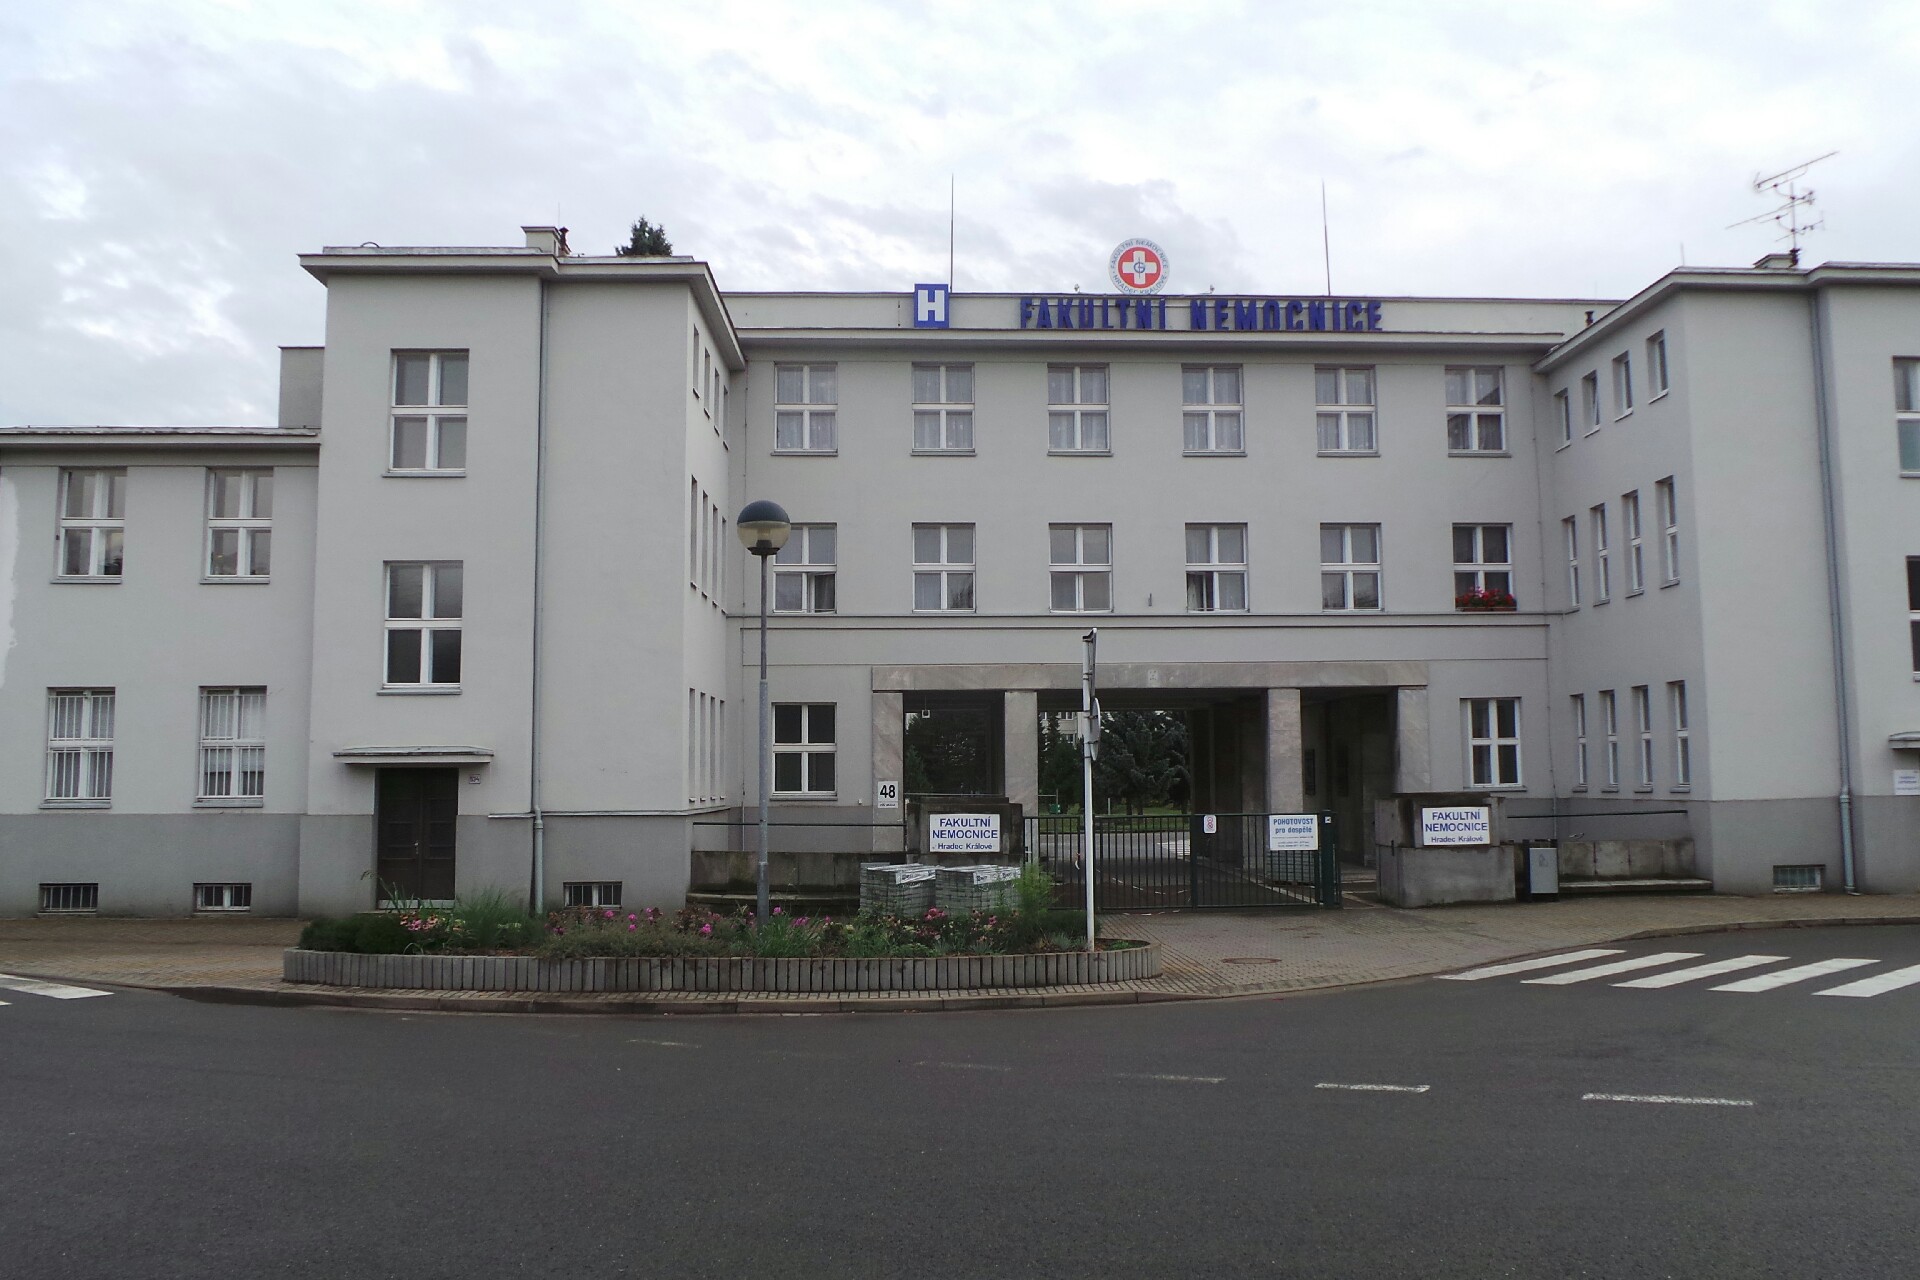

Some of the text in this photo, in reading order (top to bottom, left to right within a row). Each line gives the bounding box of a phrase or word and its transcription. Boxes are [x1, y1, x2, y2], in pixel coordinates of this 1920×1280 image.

[917, 289, 945, 322] H
[1189, 299, 1383, 331] NEMOCNICE
[880, 784, 896, 799] 48
[1432, 809, 1481, 821] FAKULTNÍ
[939, 816, 991, 827] FAKULTNÍ
[1273, 818, 1314, 826] POHOTOVOST
[1275, 826, 1312, 835] pro dospělé
[1425, 822, 1488, 832] NEMOCNICE
[932, 829, 999, 839] NEMOCNICE
[1458, 835, 1483, 843] Králové
[965, 842, 993, 850] Králové
